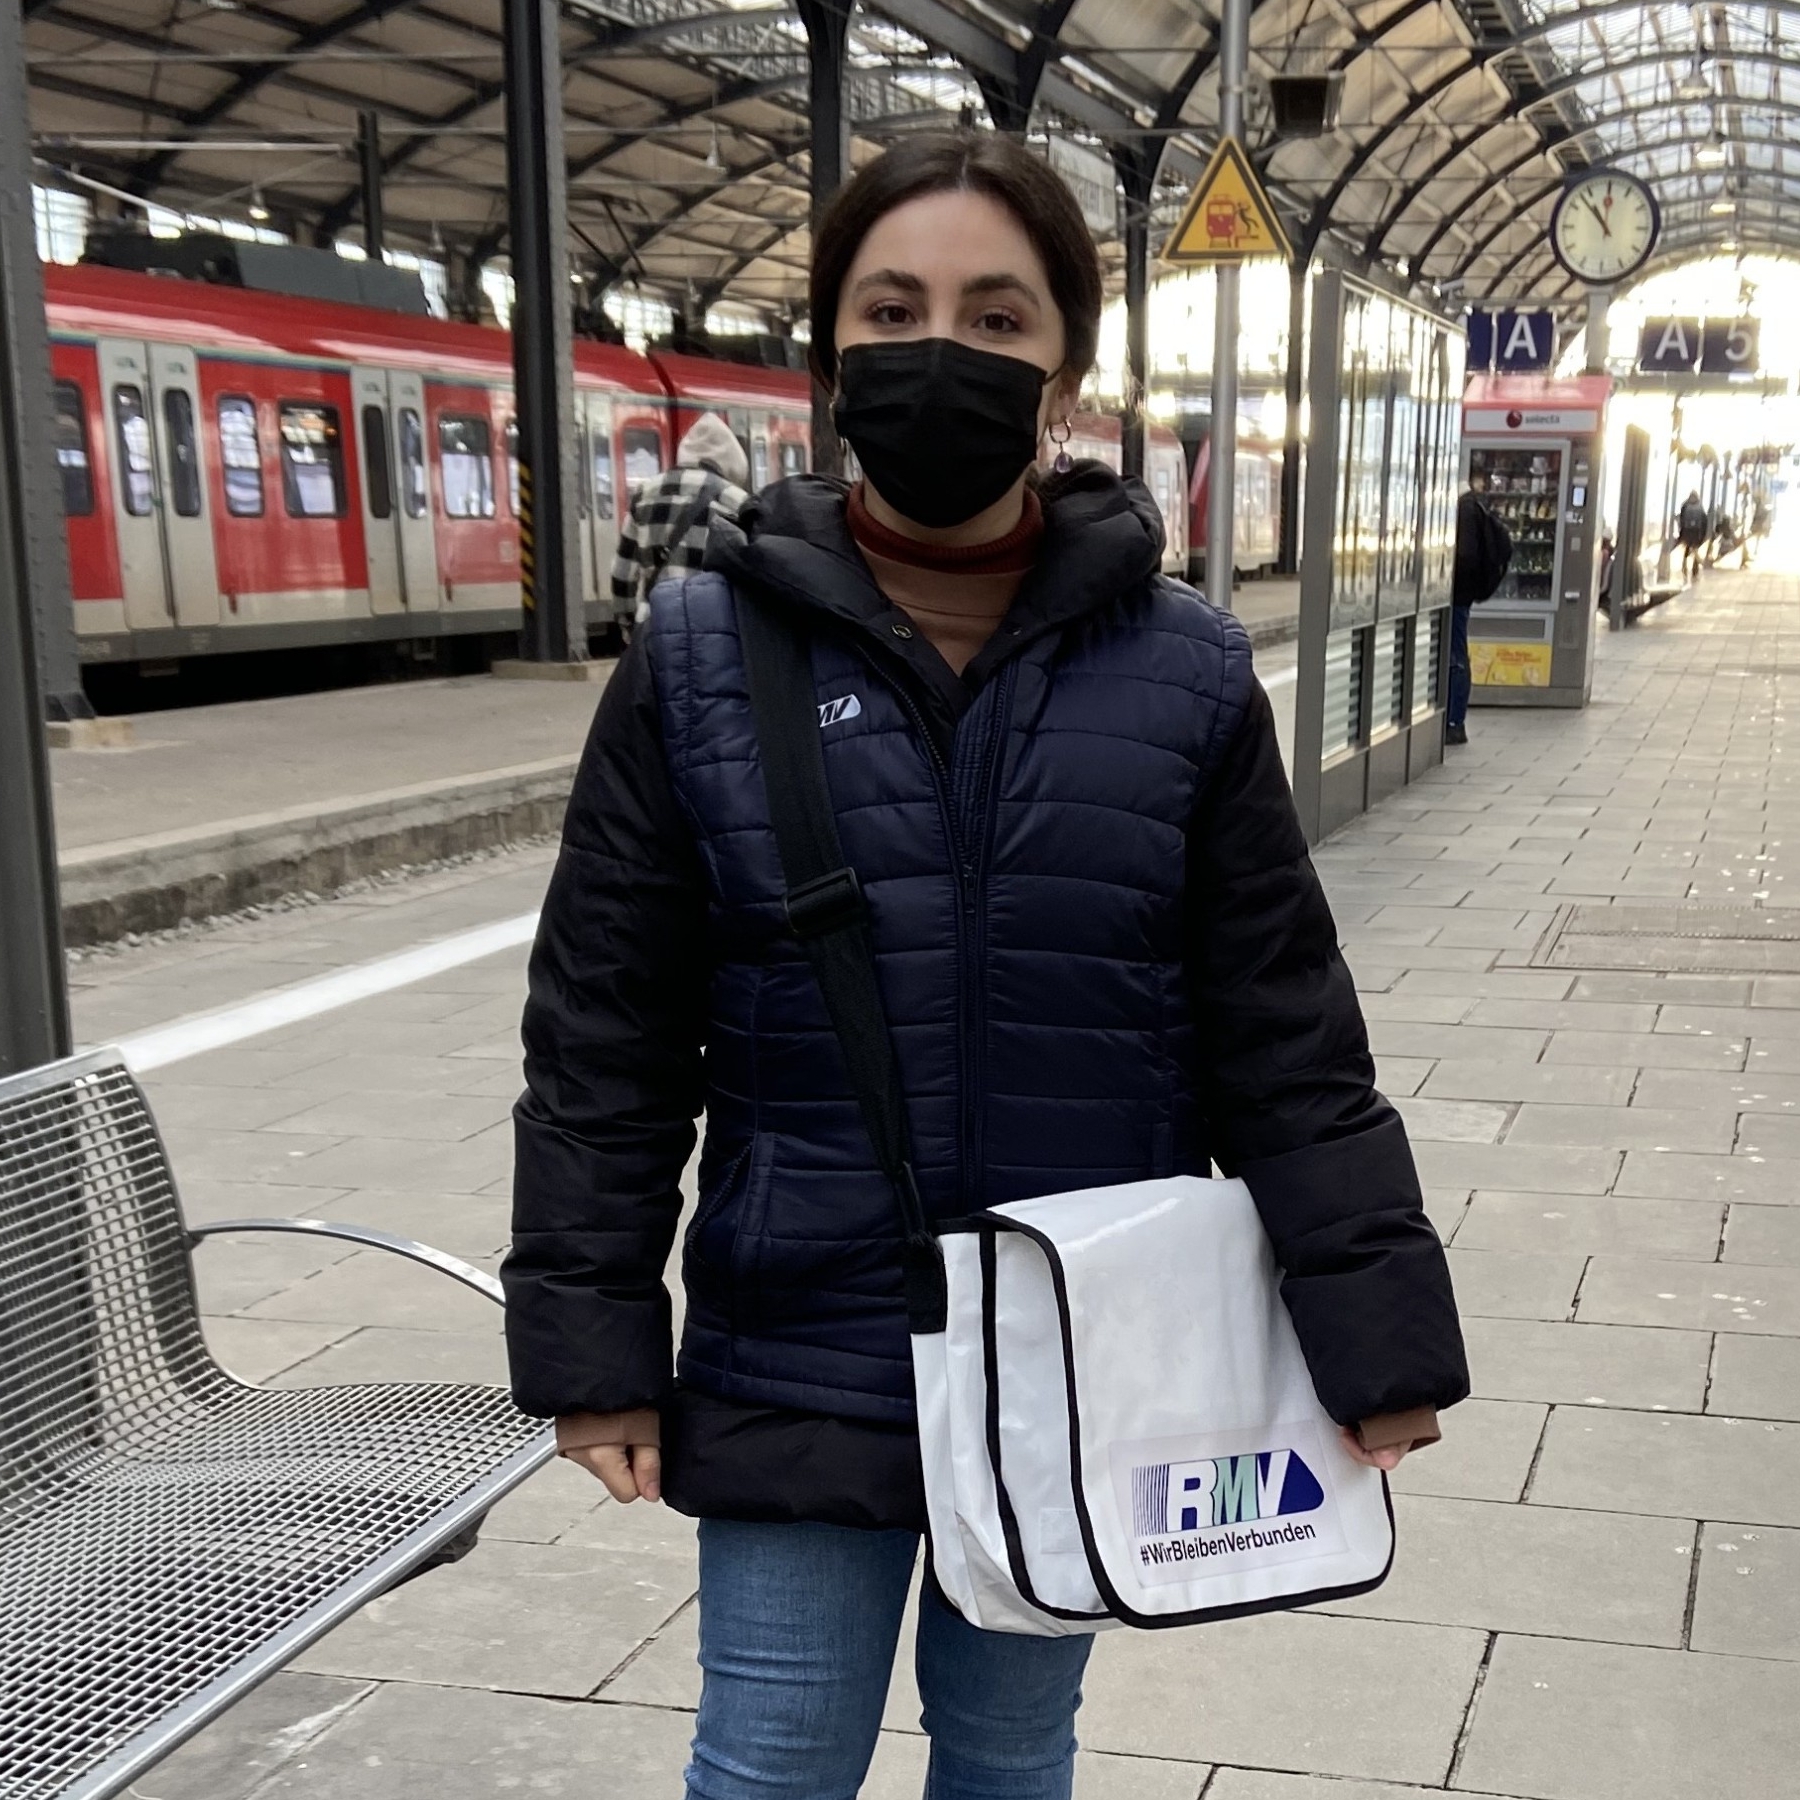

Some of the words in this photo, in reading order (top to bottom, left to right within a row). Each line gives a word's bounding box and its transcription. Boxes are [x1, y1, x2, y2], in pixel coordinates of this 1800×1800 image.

[1504, 314, 1537, 359] A
[1654, 316, 1689, 361] A
[1725, 317, 1753, 362] 5
[817, 694, 853, 728] MV
[1165, 1449, 1292, 1533] RMV
[1140, 1522, 1316, 1566] #WirBleibenVerbunden
